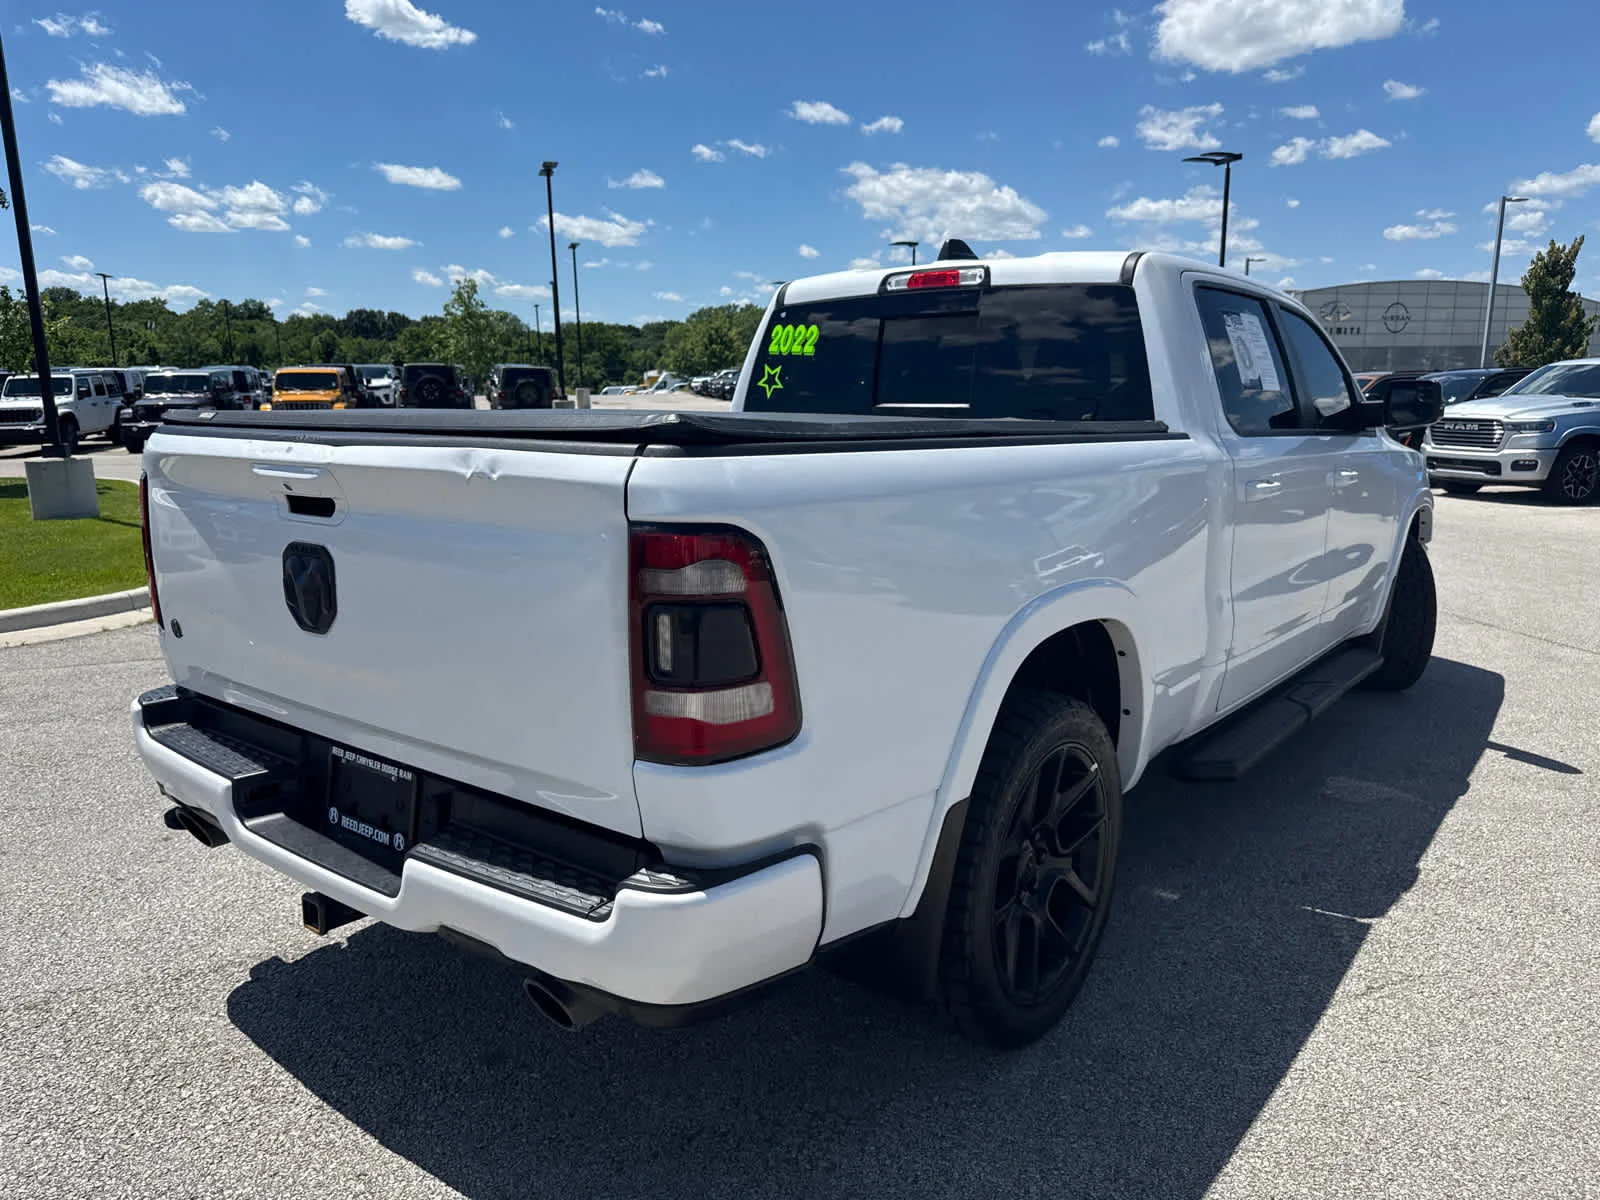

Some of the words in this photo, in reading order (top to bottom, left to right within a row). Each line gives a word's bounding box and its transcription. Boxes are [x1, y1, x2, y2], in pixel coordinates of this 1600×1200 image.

[768, 324, 819, 356] 2022
[1444, 423, 1479, 431] RAM
[332, 746, 344, 757] REED
[344, 751, 356, 761] JEEP
[356, 754, 381, 769] CHRYSLER
[381, 763, 398, 777] DODGE
[399, 768, 412, 781] RAM
[341, 815, 389, 846] REEDJEEP.COM
